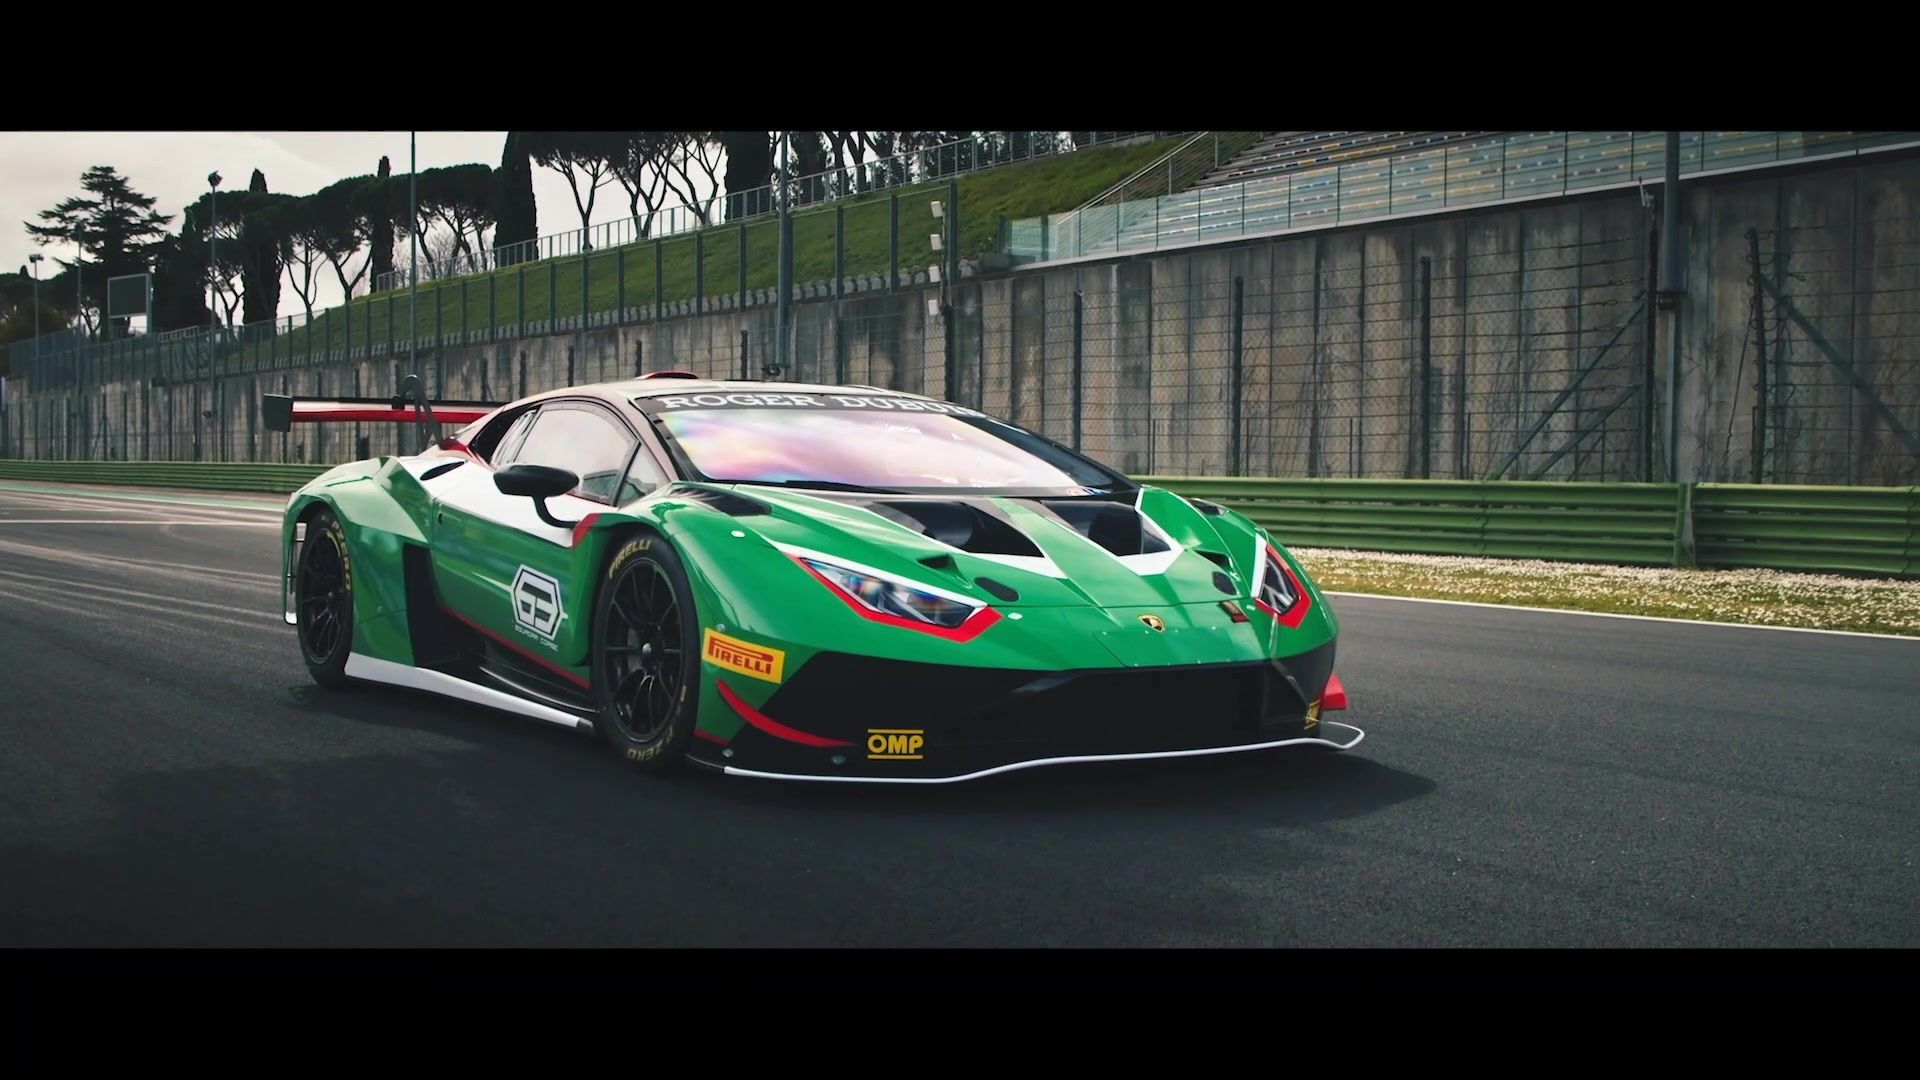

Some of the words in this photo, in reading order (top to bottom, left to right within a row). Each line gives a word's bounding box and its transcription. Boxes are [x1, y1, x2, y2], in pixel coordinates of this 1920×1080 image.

[657, 394, 826, 409] ROGER
[609, 539, 652, 580] PIRELLI
[708, 636, 774, 675] PIRELLI
[867, 734, 924, 754] OMP
